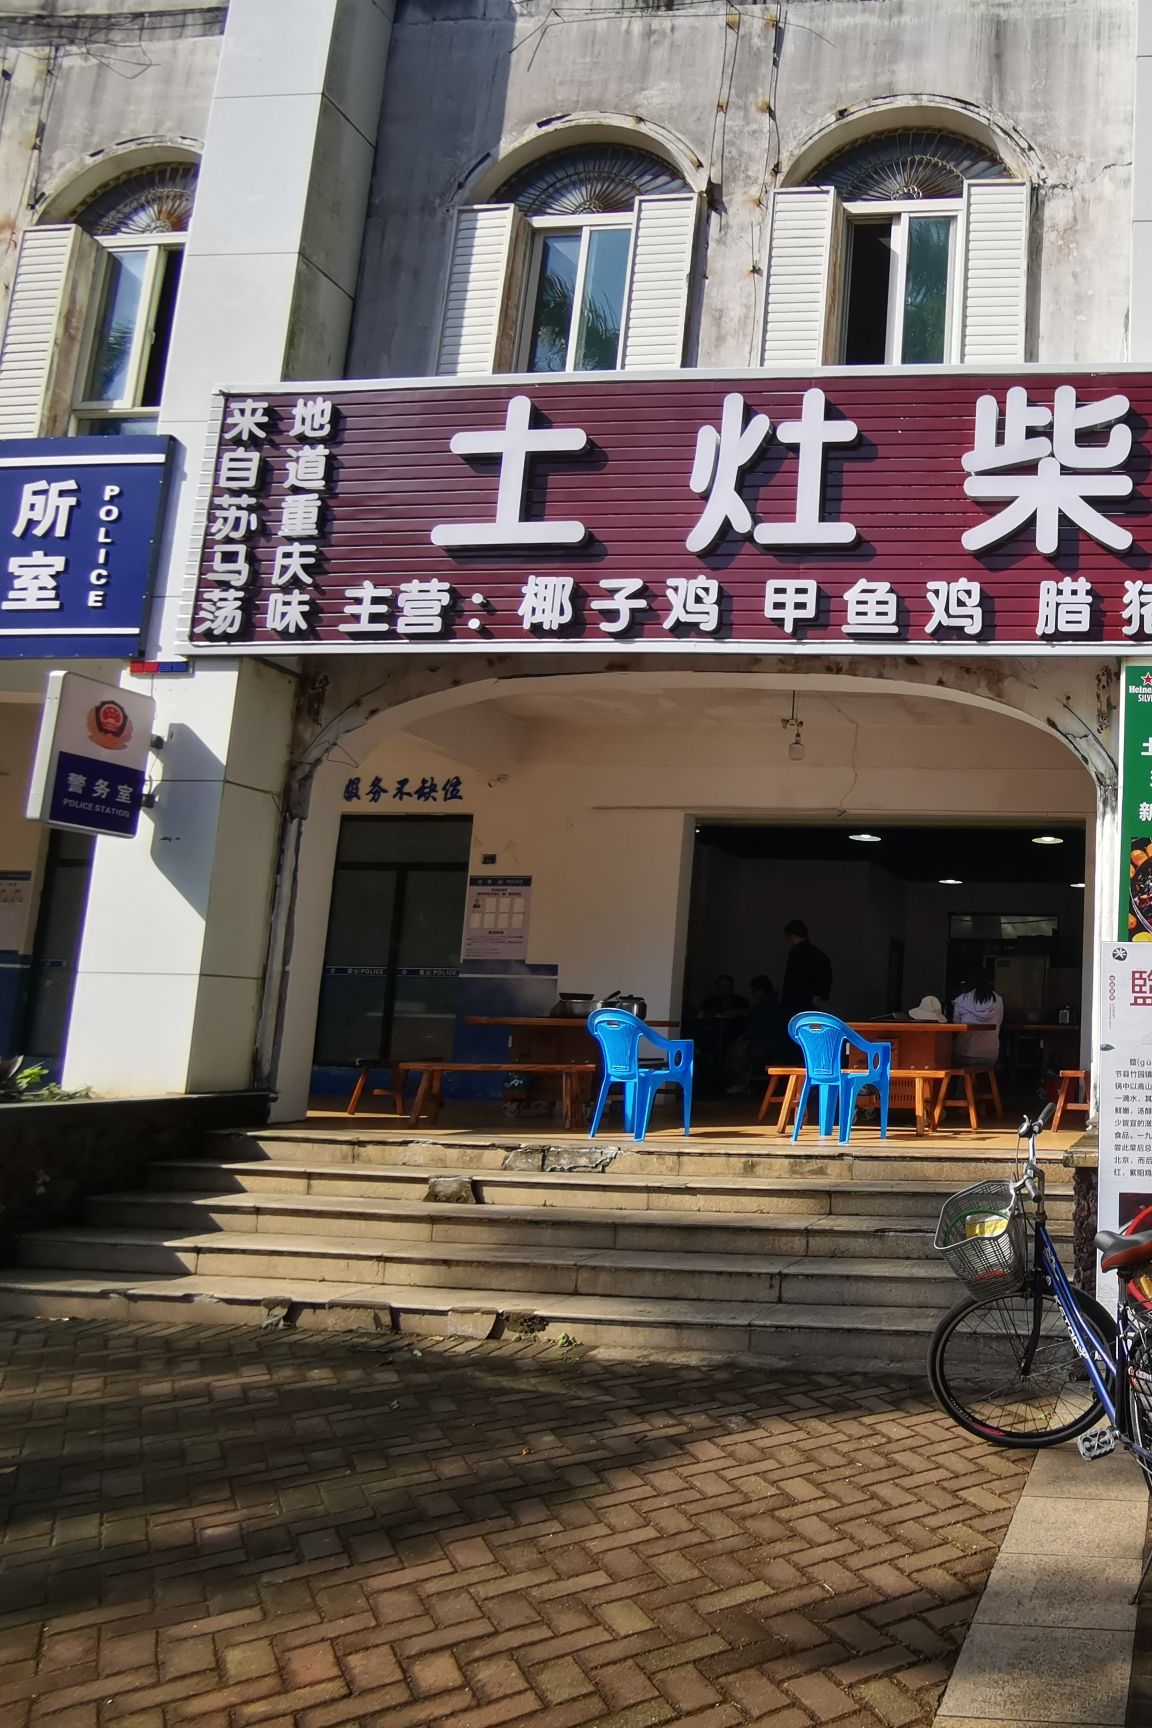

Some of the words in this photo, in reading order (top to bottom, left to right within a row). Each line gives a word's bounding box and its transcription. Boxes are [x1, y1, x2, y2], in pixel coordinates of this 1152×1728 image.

[12, 480, 79, 538] 所
[194, 397, 269, 636] 来自苏马荡
[265, 397, 332, 634] 地道重庆味
[88, 485, 120, 607] POLICE
[1, 551, 66, 610] 室
[517, 575, 720, 634] 椰子鸡
[764, 576, 982, 636] 甲鱼鸡
[63, 798, 96, 812] POLICE
[95, 802, 131, 818] STATION
[67, 772, 134, 804] 警务室
[343, 775, 464, 803] 服务不缺位
